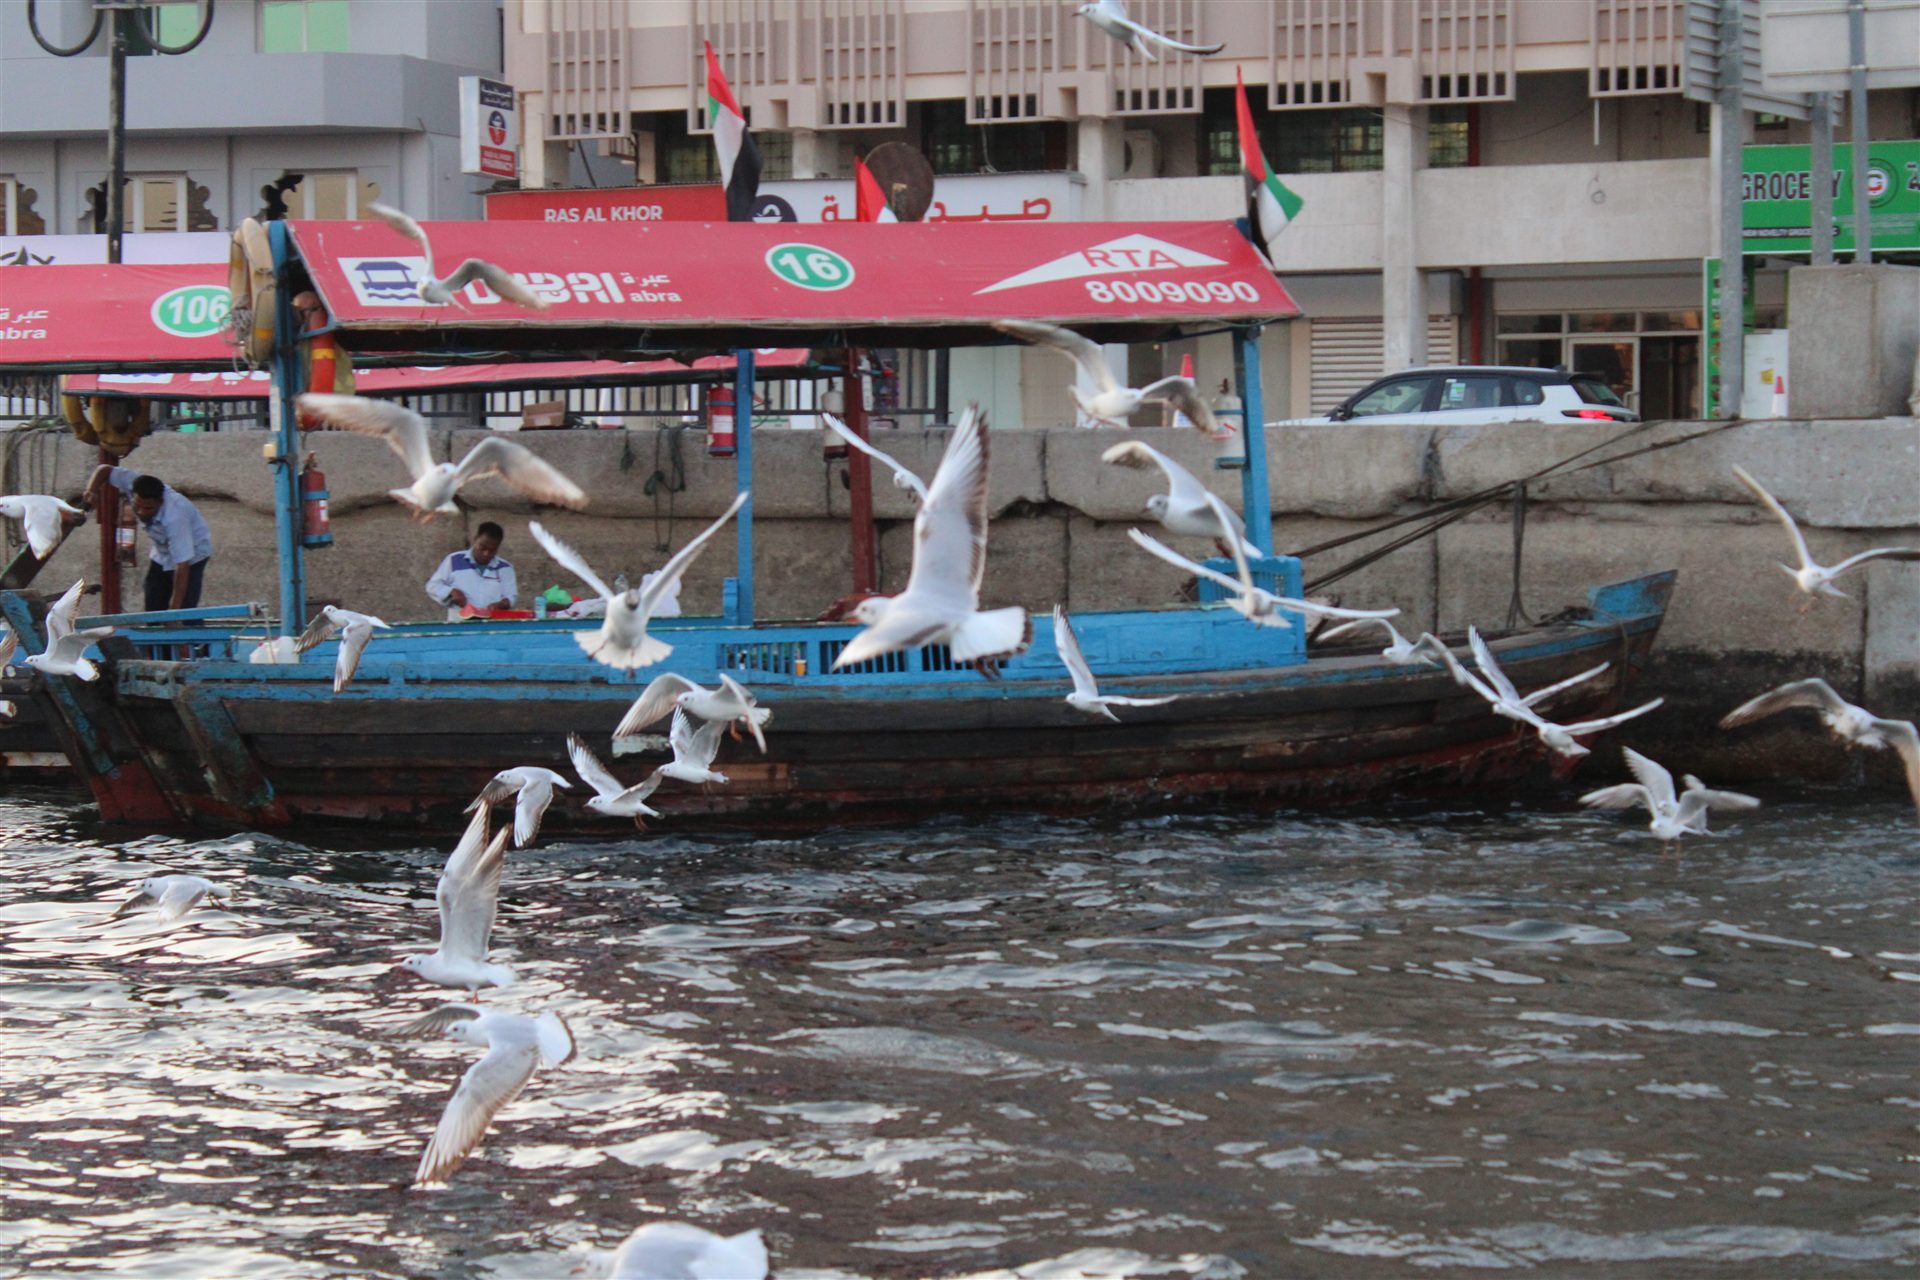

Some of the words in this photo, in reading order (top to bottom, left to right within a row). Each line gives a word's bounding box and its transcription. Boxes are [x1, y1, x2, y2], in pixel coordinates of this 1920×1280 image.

[1742, 171, 1843, 200] GROCEY
[544, 208, 579, 222] RAS
[583, 208, 606, 222] AL
[611, 205, 663, 221] KHOR
[778, 252, 842, 281] 16
[1080, 249, 1187, 268] RTA
[620, 272, 671, 287] عبرة
[629, 290, 682, 302] abra
[1085, 280, 1260, 303] 8009090
[168, 294, 229, 325] 106
[0, 327, 47, 340] bra
